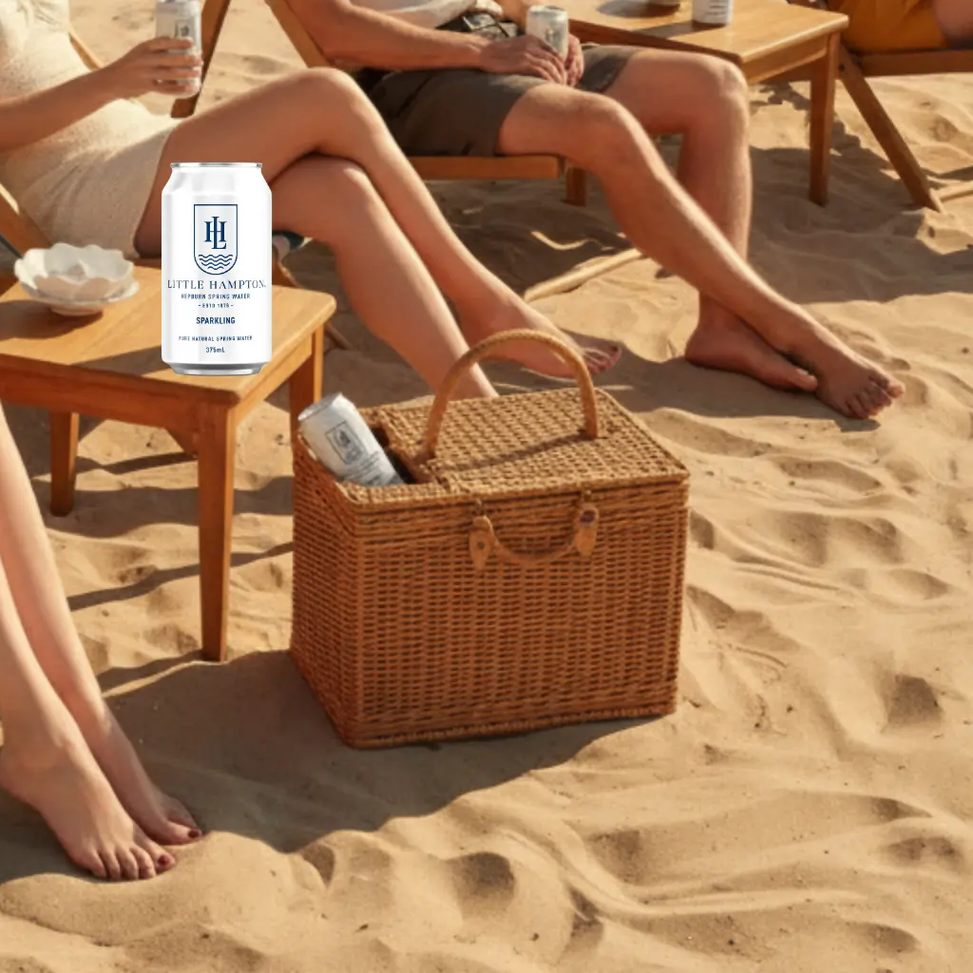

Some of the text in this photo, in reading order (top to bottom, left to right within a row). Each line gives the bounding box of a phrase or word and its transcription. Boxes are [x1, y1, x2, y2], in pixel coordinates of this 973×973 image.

[167, 279, 266, 290] LITTLE HAMPTON
[196, 316, 236, 324] SPARKLING
